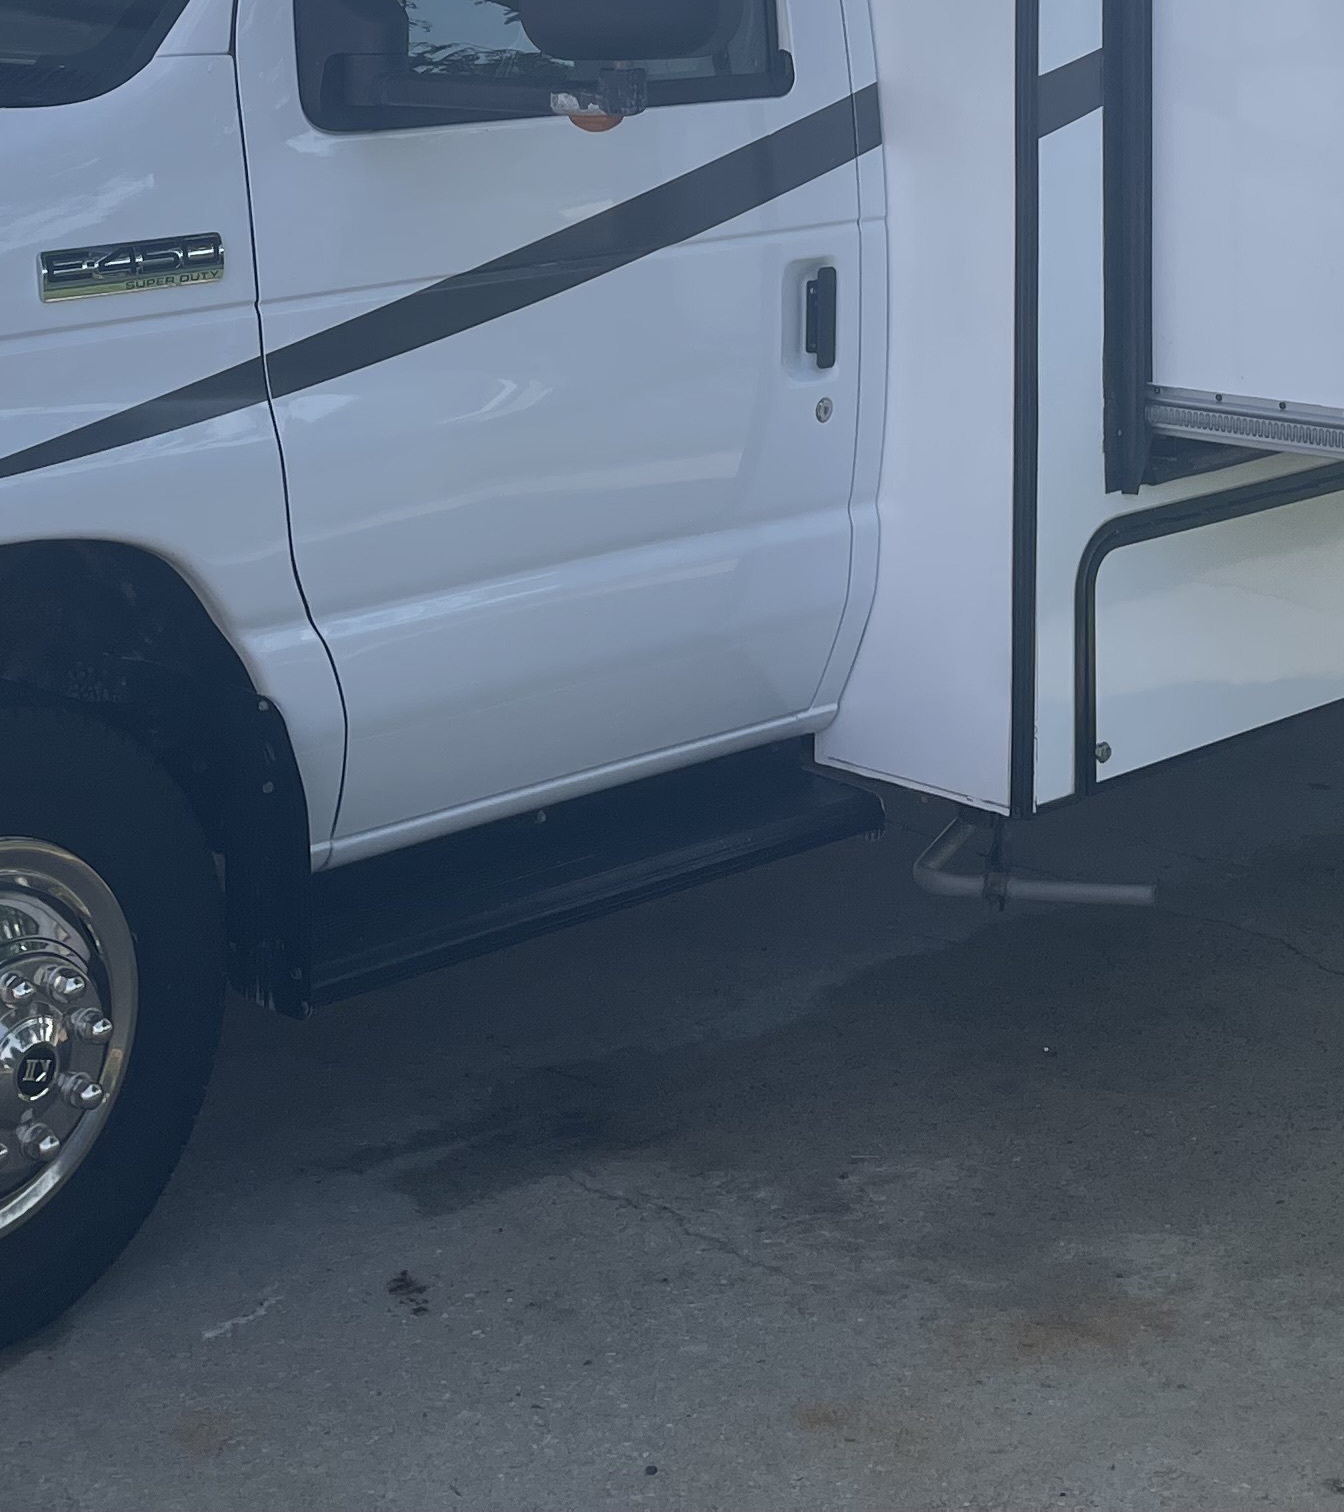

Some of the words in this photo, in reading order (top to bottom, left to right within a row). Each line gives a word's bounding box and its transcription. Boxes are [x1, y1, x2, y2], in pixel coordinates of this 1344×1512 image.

[45, 235, 222, 283] E-450
[125, 276, 175, 290] SUPER
[179, 270, 219, 284] DUTY
